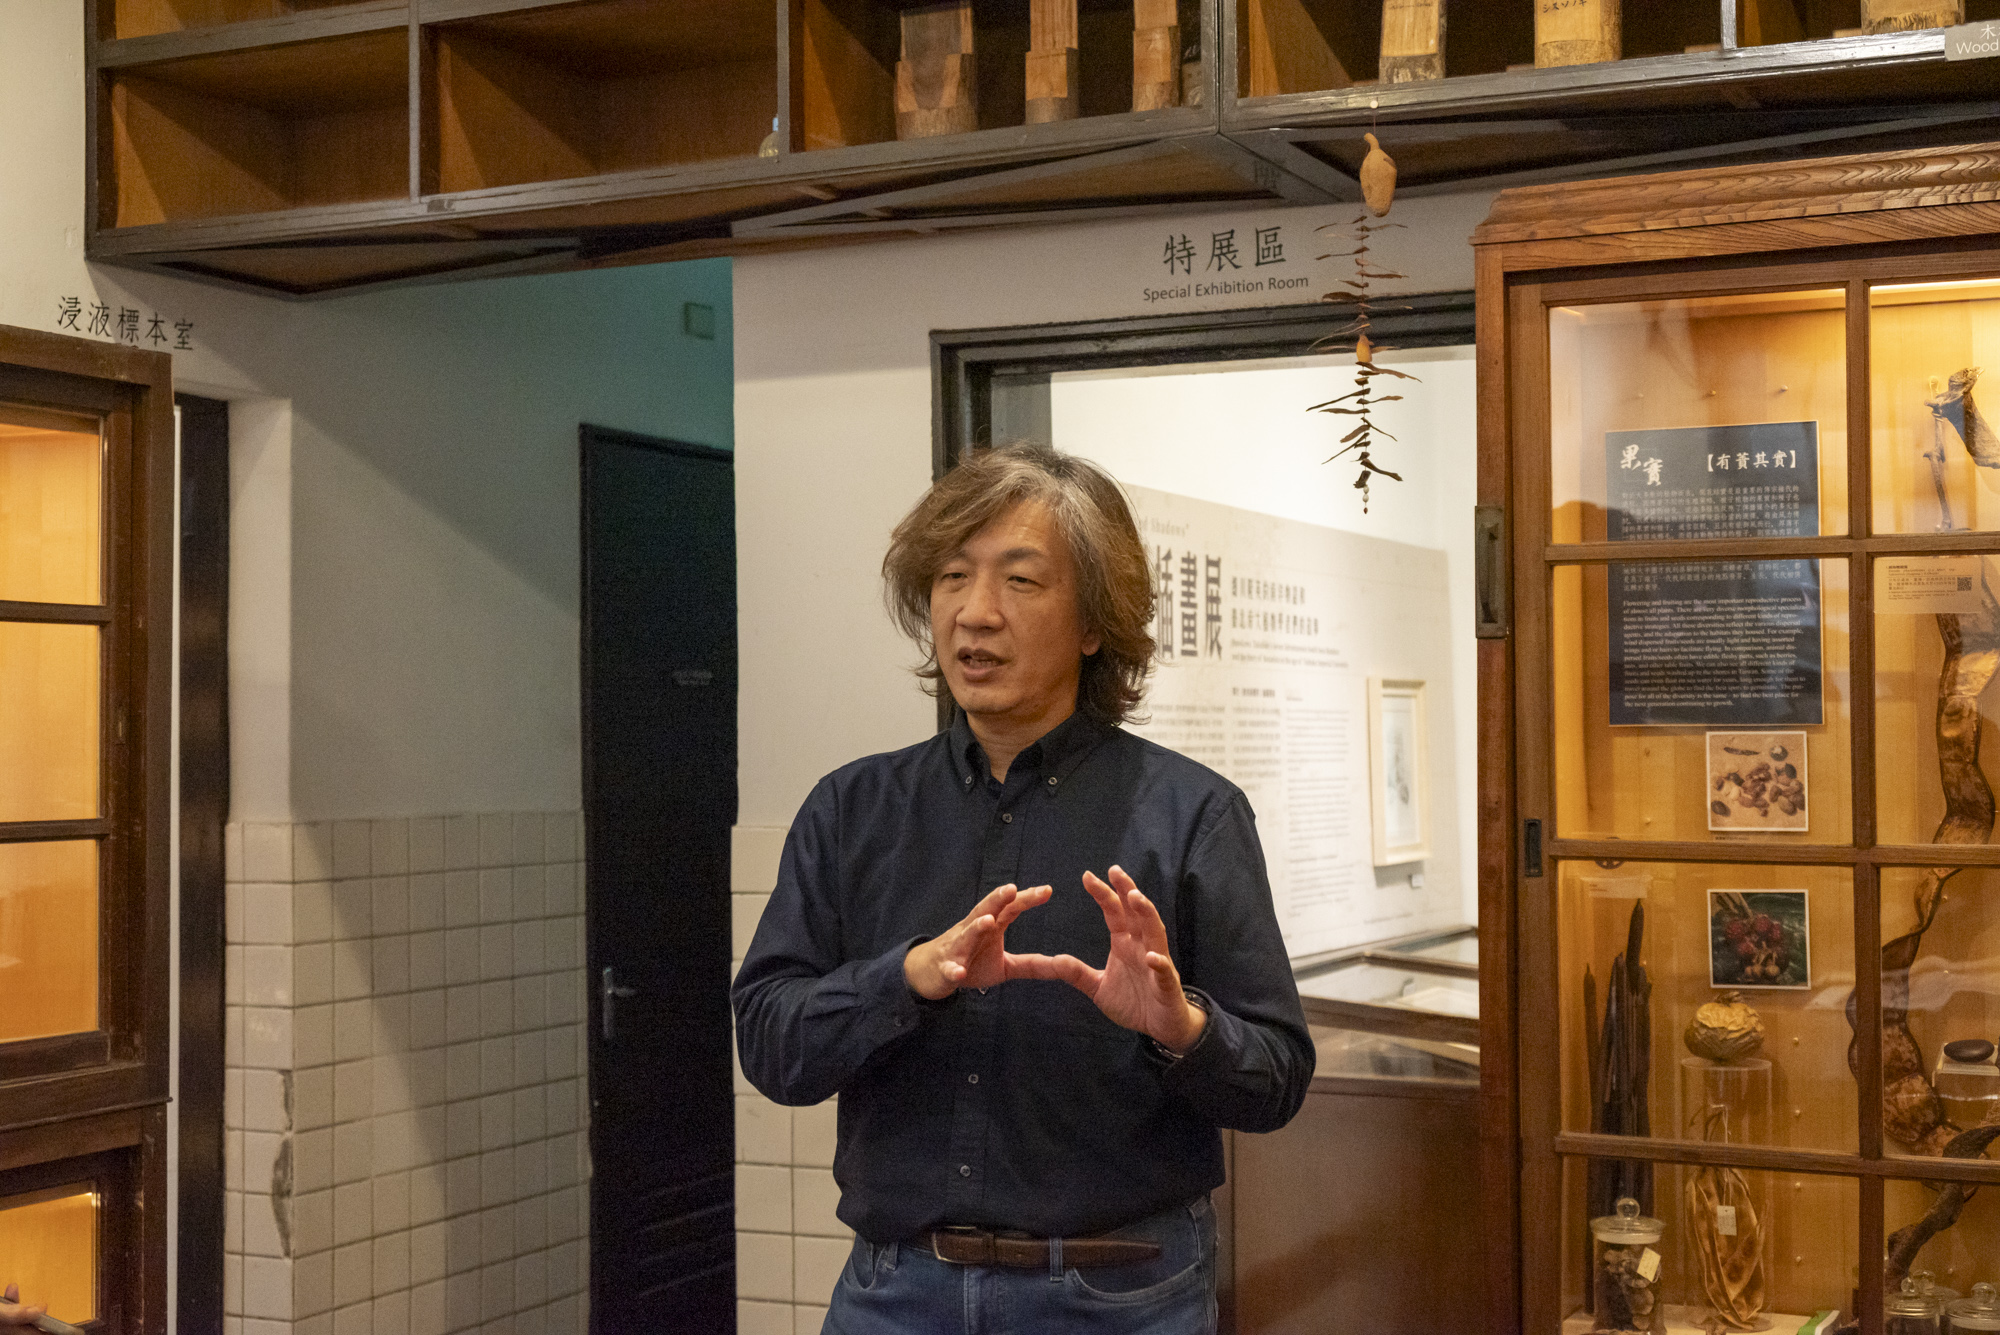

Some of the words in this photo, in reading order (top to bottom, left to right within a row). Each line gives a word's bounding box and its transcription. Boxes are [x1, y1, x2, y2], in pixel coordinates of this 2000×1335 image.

[1956, 39, 1999, 54] Wood
[1163, 226, 1287, 276] 特展區
[1143, 283, 1191, 303] Special
[1195, 278, 1264, 298] Exhibition
[1268, 276, 1309, 291] Room
[57, 295, 194, 350] 浸液標本室
